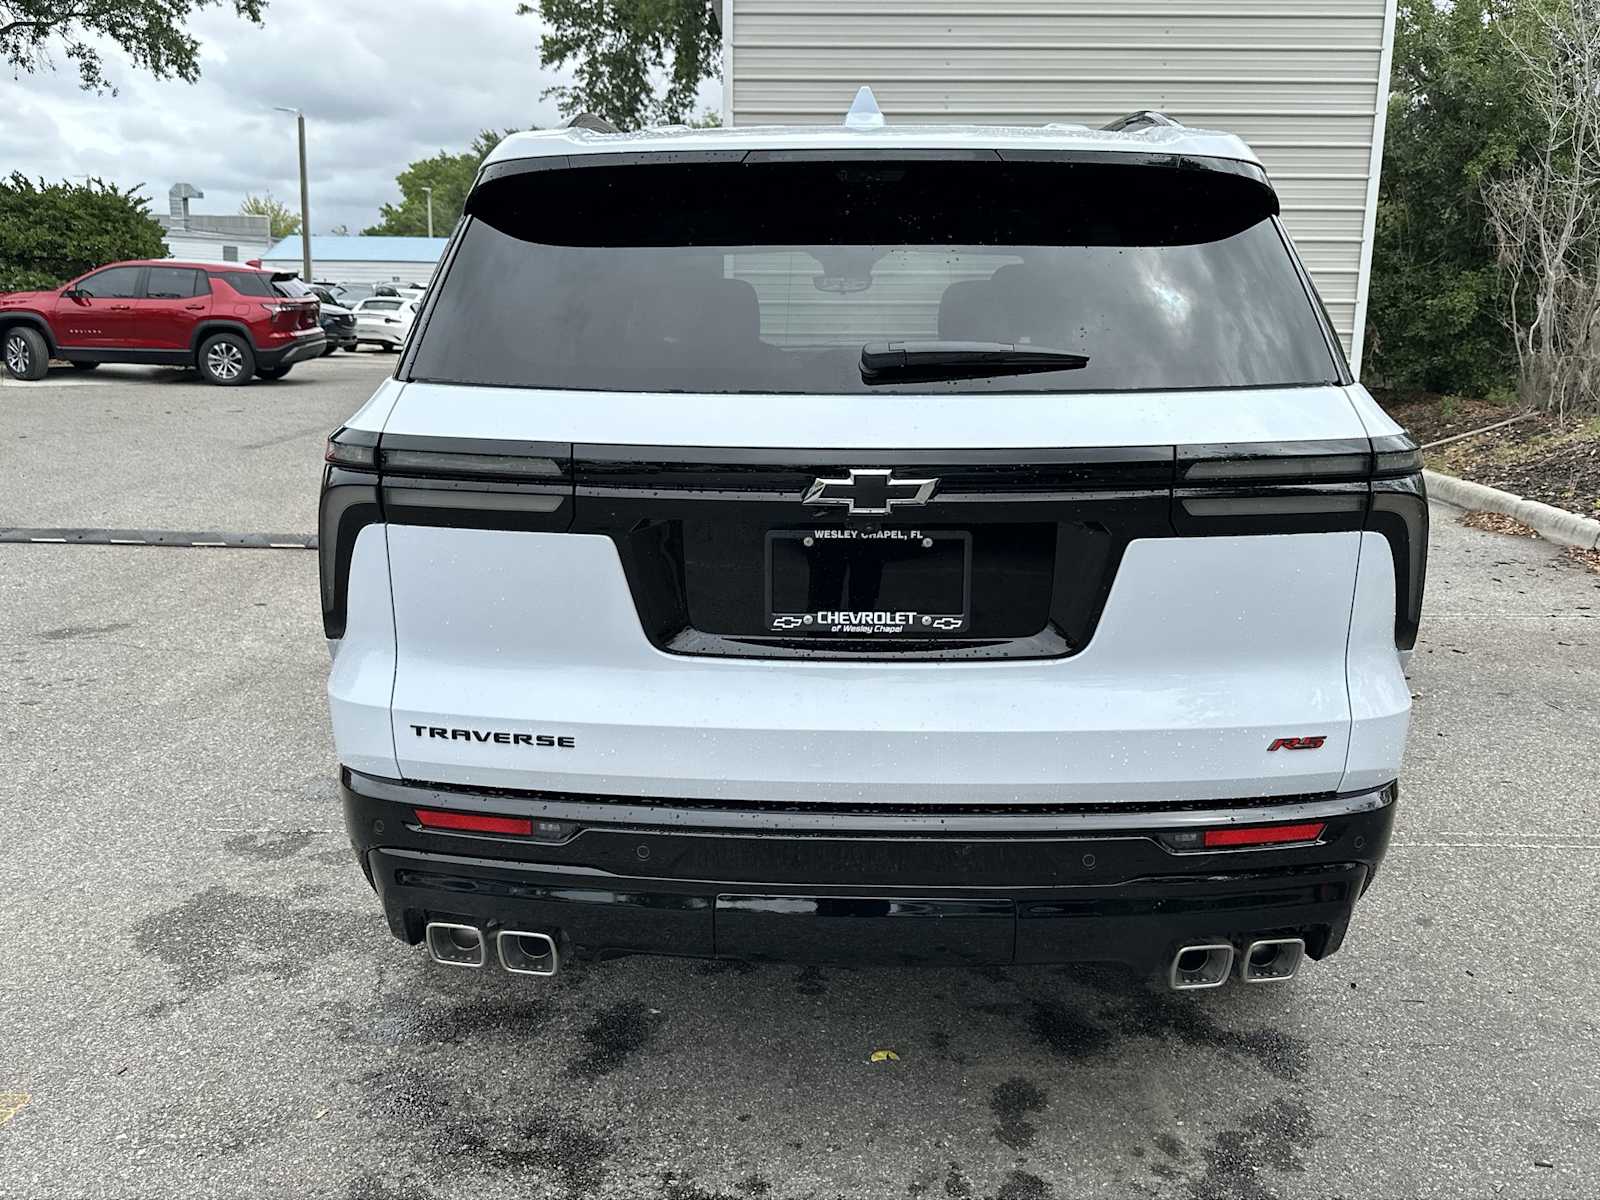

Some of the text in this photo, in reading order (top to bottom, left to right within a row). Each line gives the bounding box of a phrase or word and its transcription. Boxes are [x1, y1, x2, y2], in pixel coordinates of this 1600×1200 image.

[814, 530, 858, 539] WESLEY
[910, 530, 923, 539] FL
[817, 611, 917, 625] CHEVROLET
[831, 625, 903, 634] of Wesley Chapel
[410, 724, 576, 749] TRAVERSE
[1267, 736, 1327, 751] RS
